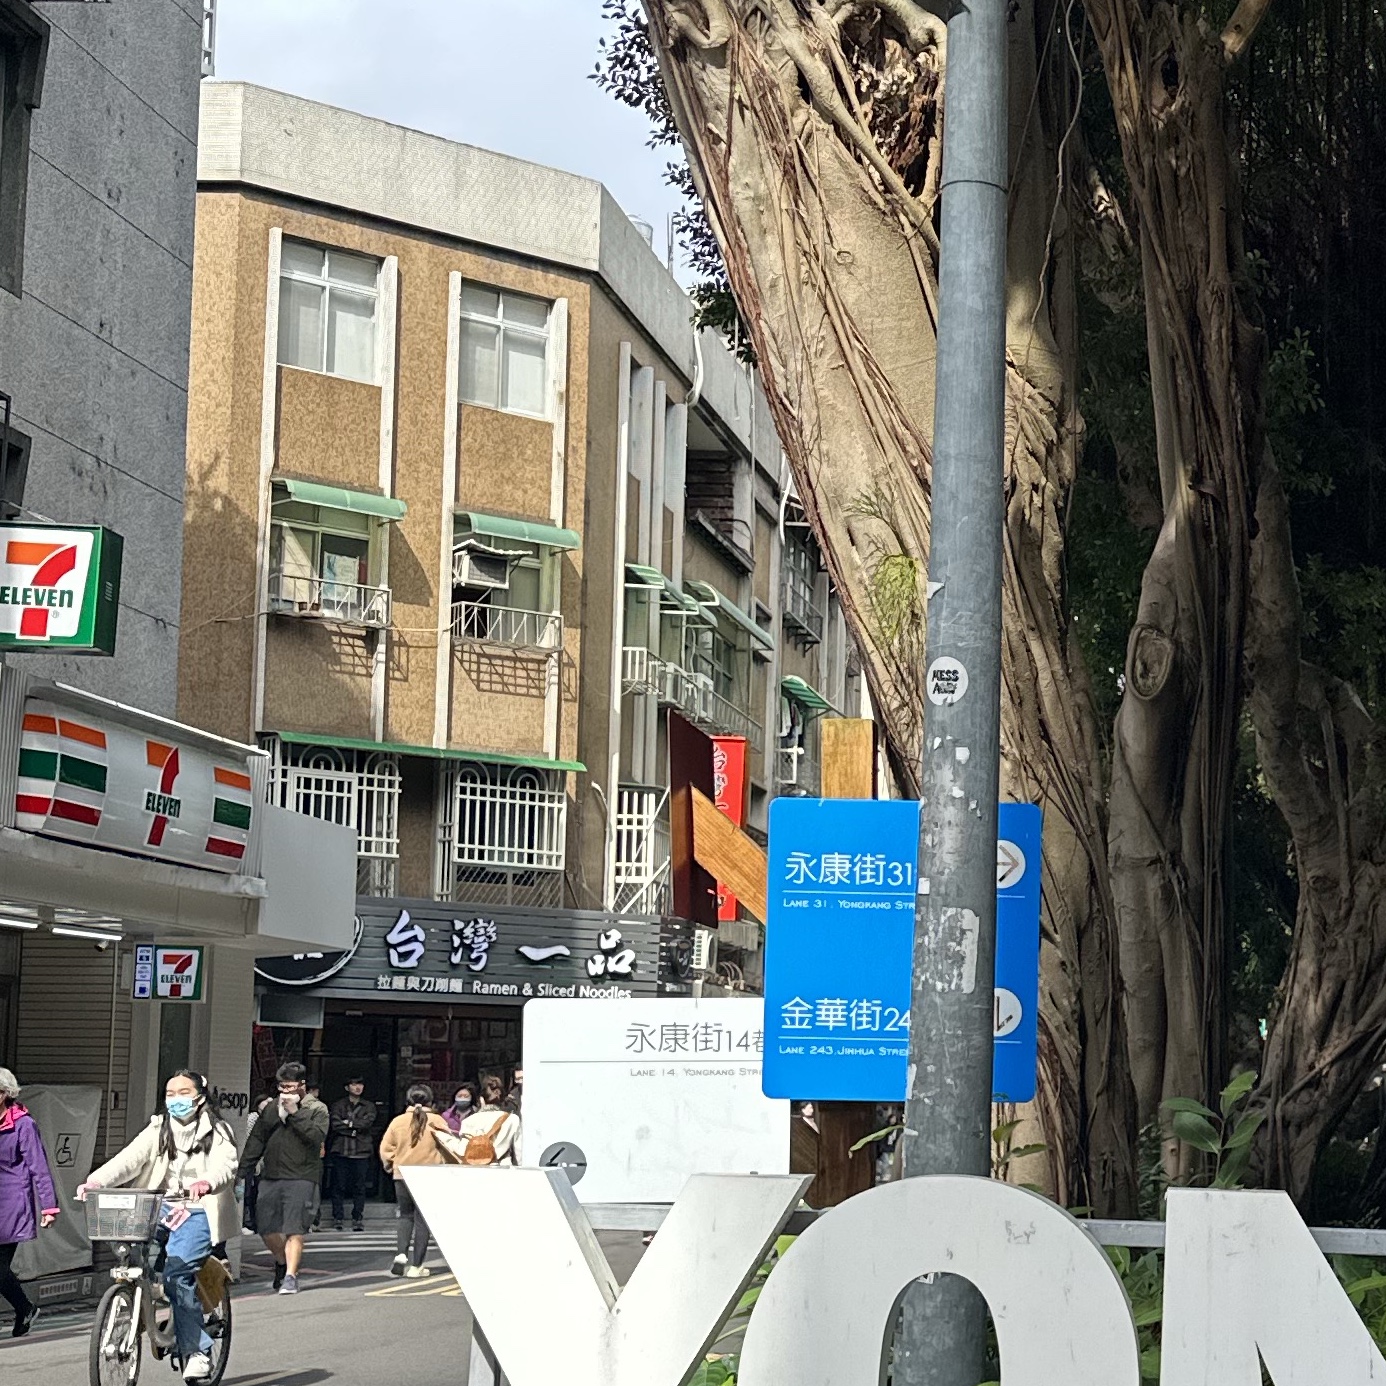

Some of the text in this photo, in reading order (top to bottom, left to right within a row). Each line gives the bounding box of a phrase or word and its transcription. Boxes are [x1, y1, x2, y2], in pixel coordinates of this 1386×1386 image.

[6, 541, 77, 637] 7
[146, 740, 180, 847] 7
[783, 898, 809, 908] LANE
[838, 899, 892, 910] YONGKANG
[386, 909, 636, 977] 台灣一品
[163, 954, 193, 997] 7
[472, 980, 632, 999] Ramen & Sliced Noodles
[779, 1045, 805, 1055] LANE
[630, 1068, 656, 1077] LANE
[682, 1068, 735, 1077] YONGKANG
